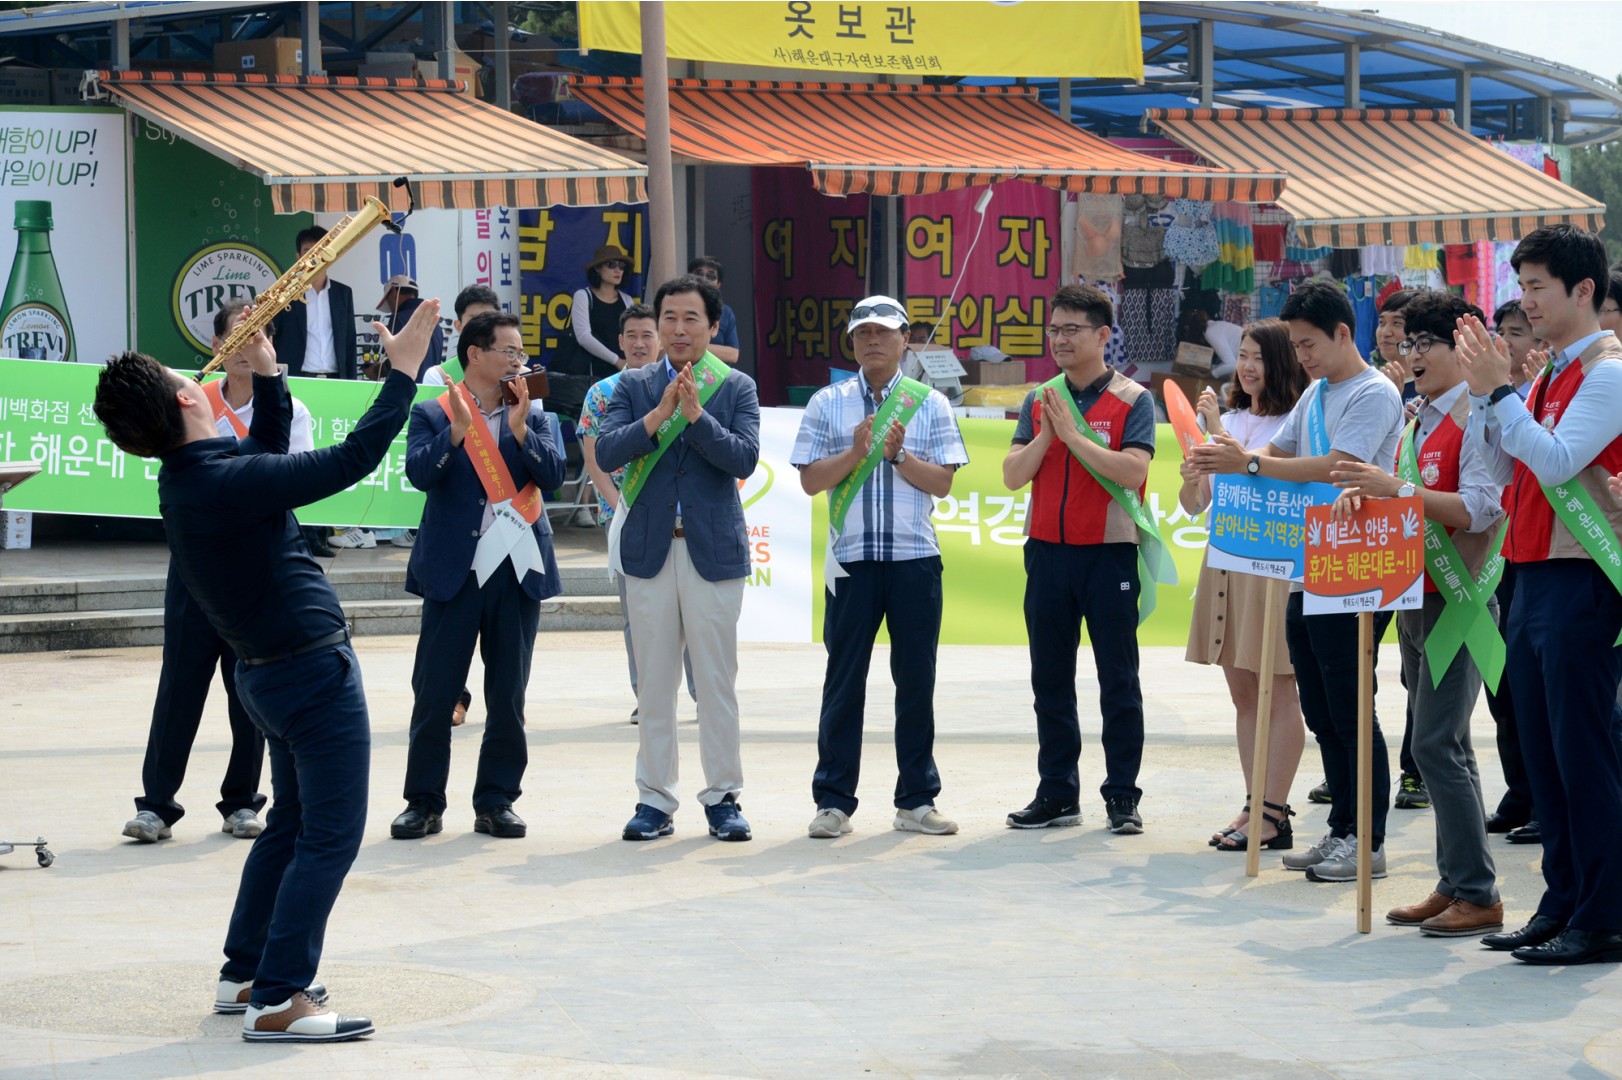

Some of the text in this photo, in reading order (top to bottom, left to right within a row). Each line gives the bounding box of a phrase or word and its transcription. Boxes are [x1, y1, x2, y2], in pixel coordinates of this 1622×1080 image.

[193, 252, 270, 278] LIME SPARKLING
[212, 265, 252, 281] Lime
[7, 309, 61, 330] LEMON SPARKLING
[4, 331, 63, 354] TREVI
[1423, 451, 1442, 459] LOTTE
[1217, 481, 1263, 512] 함께하는
[1214, 512, 1261, 542] 살아나는
[1325, 519, 1362, 550] 메르스
[1308, 553, 1344, 584] 휴가는
[1434, 554, 1472, 603] 만들기
